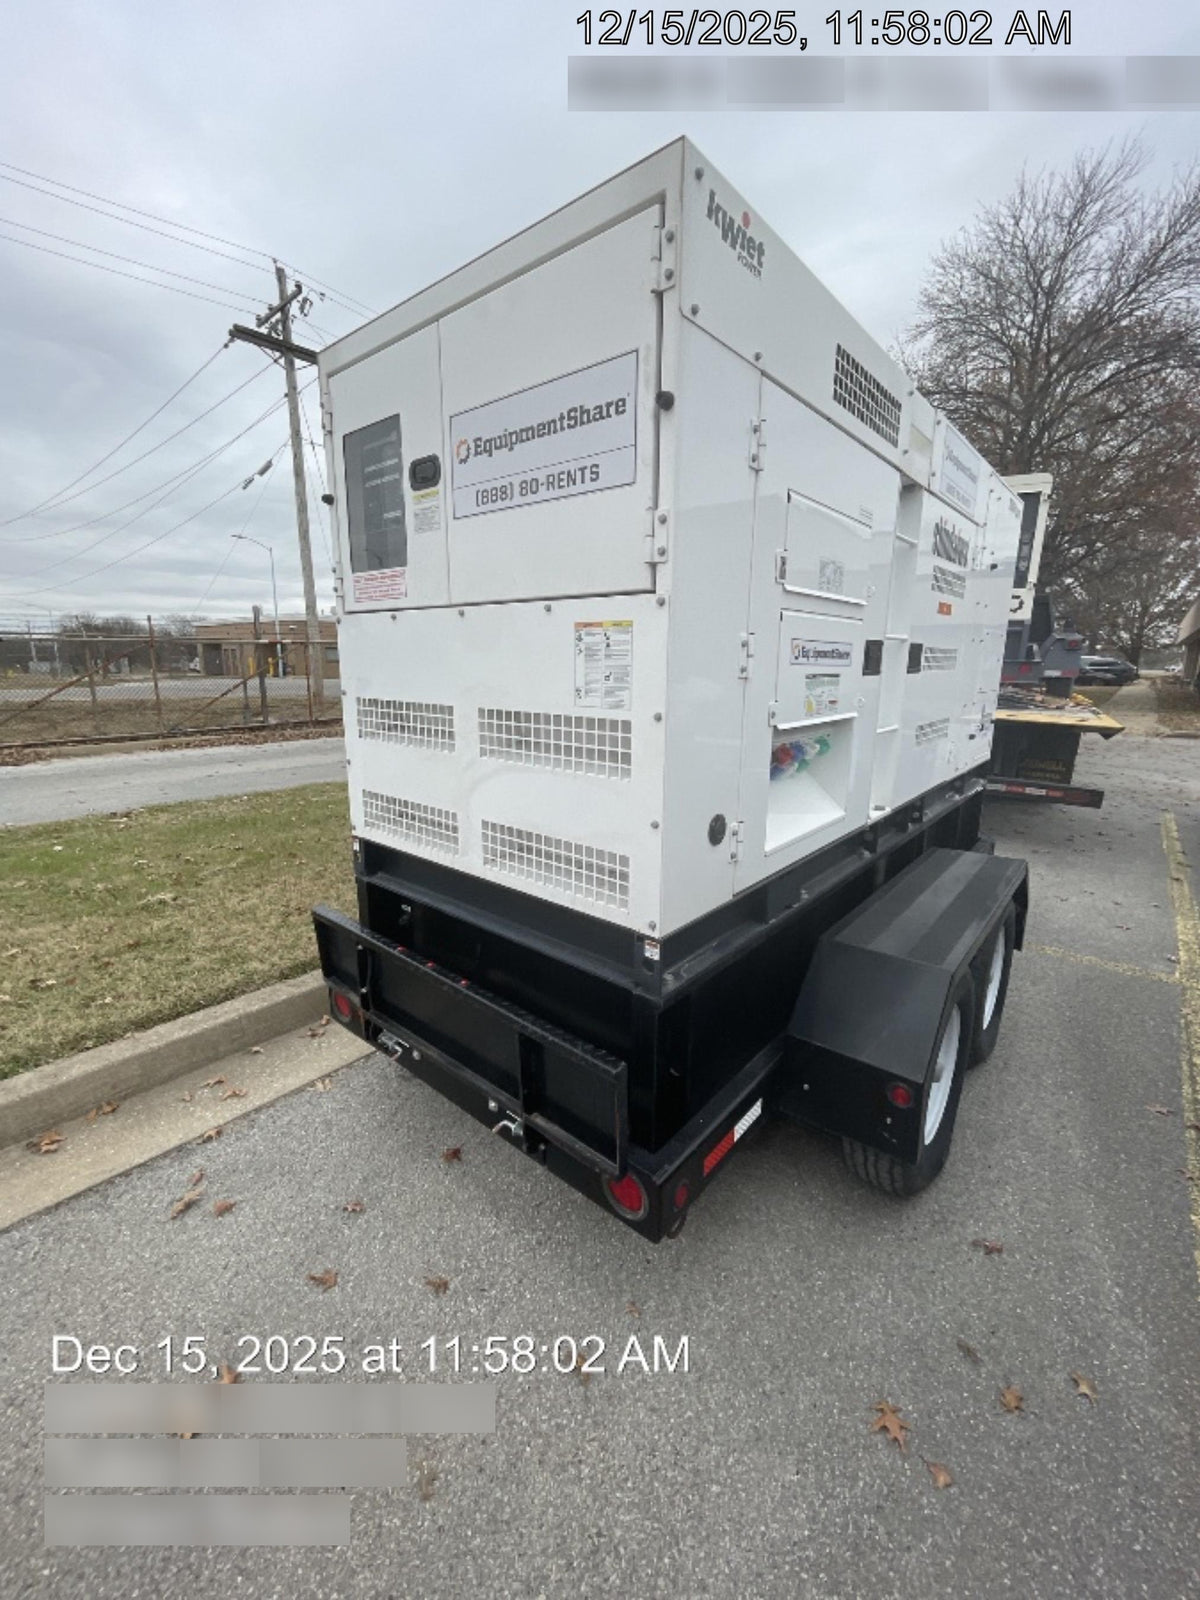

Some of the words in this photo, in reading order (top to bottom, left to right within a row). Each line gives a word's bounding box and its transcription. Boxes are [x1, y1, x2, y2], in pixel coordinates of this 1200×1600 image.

[472, 397, 627, 457] EquipmentShare
[475, 481, 514, 507] (888)
[519, 463, 600, 498] 80-RENTS
